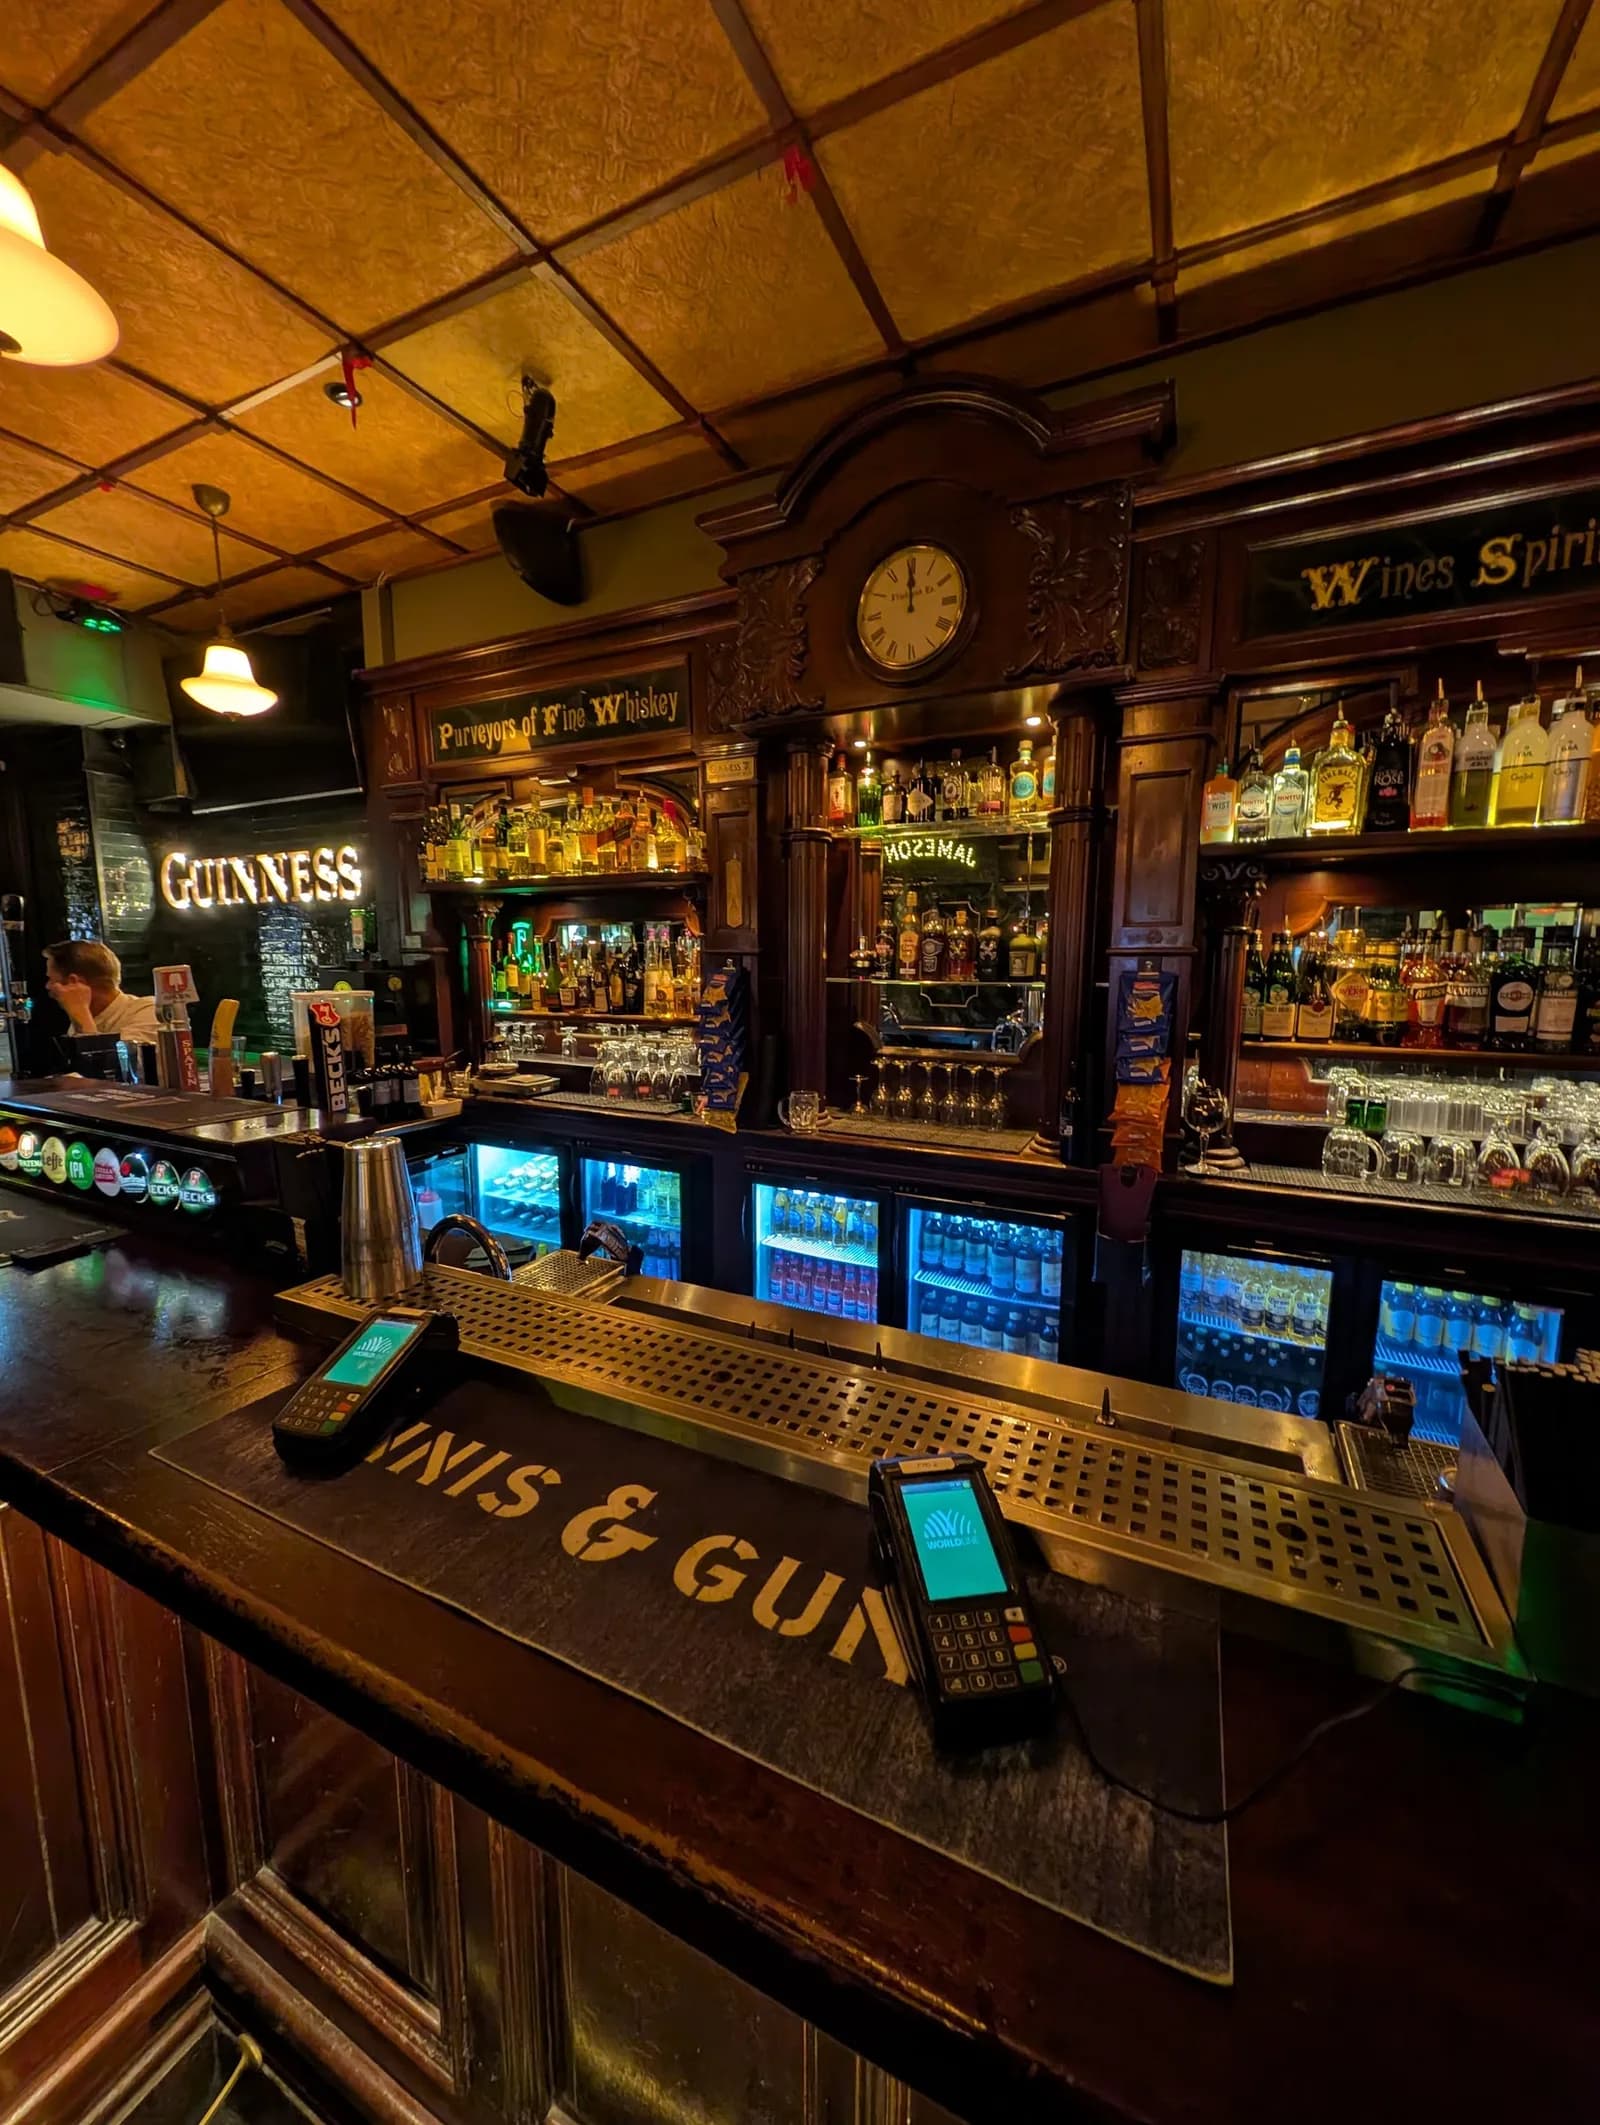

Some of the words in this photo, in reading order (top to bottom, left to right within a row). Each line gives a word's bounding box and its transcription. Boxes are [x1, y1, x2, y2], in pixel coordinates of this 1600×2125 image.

[1301, 555, 1455, 611] Wines
[1469, 517, 1600, 588] Spiri
[439, 717, 516, 750] Purveyors
[521, 706, 538, 737] of
[541, 702, 586, 737] Fine
[590, 686, 680, 727] Whiskey
[160, 845, 363, 910] GUINNESS
[181, 1040, 197, 1087] SPATEN
[322, 1027, 346, 1112] BECK'S
[69, 1161, 85, 1179] IPA
[560, 1484, 659, 1562] &
